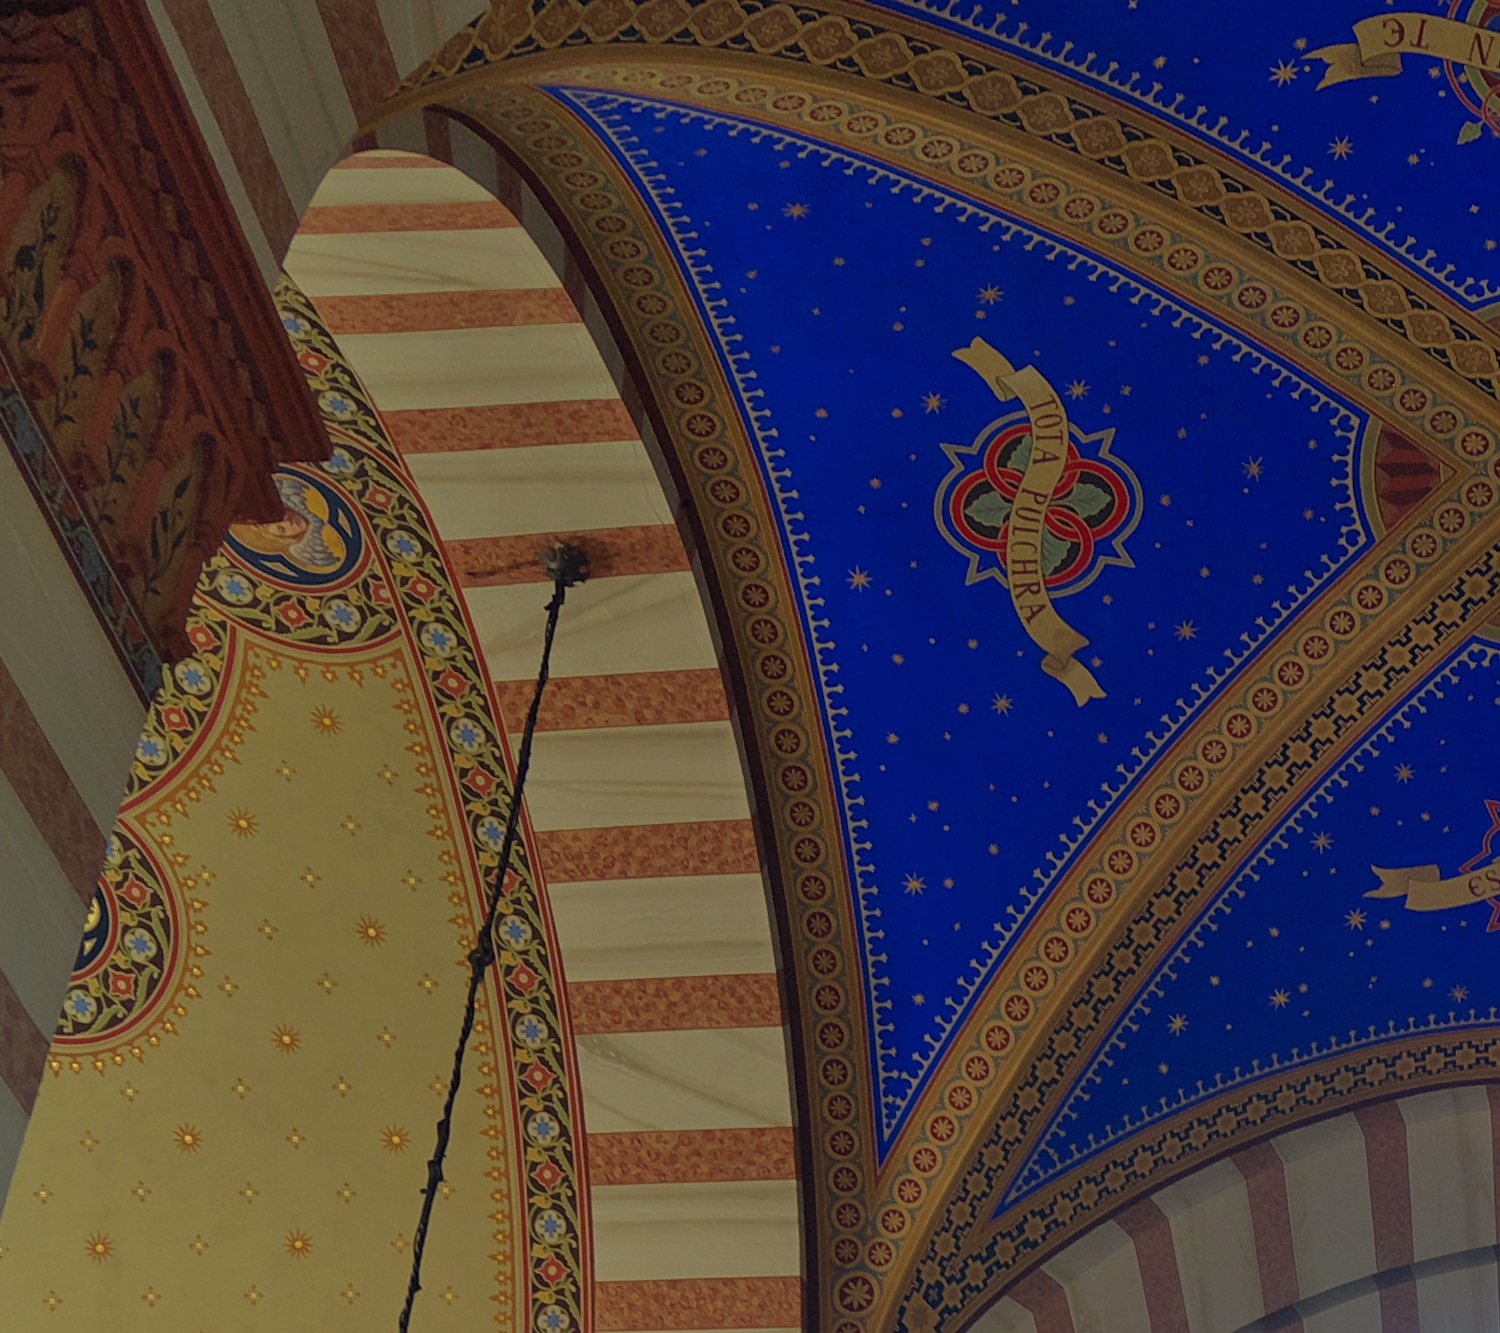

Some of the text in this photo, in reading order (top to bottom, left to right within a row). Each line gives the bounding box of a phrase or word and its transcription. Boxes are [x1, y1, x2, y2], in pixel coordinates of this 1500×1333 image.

[1381, 18, 1430, 48] TE
[1010, 394, 1066, 625] TOTA PULCHRA
